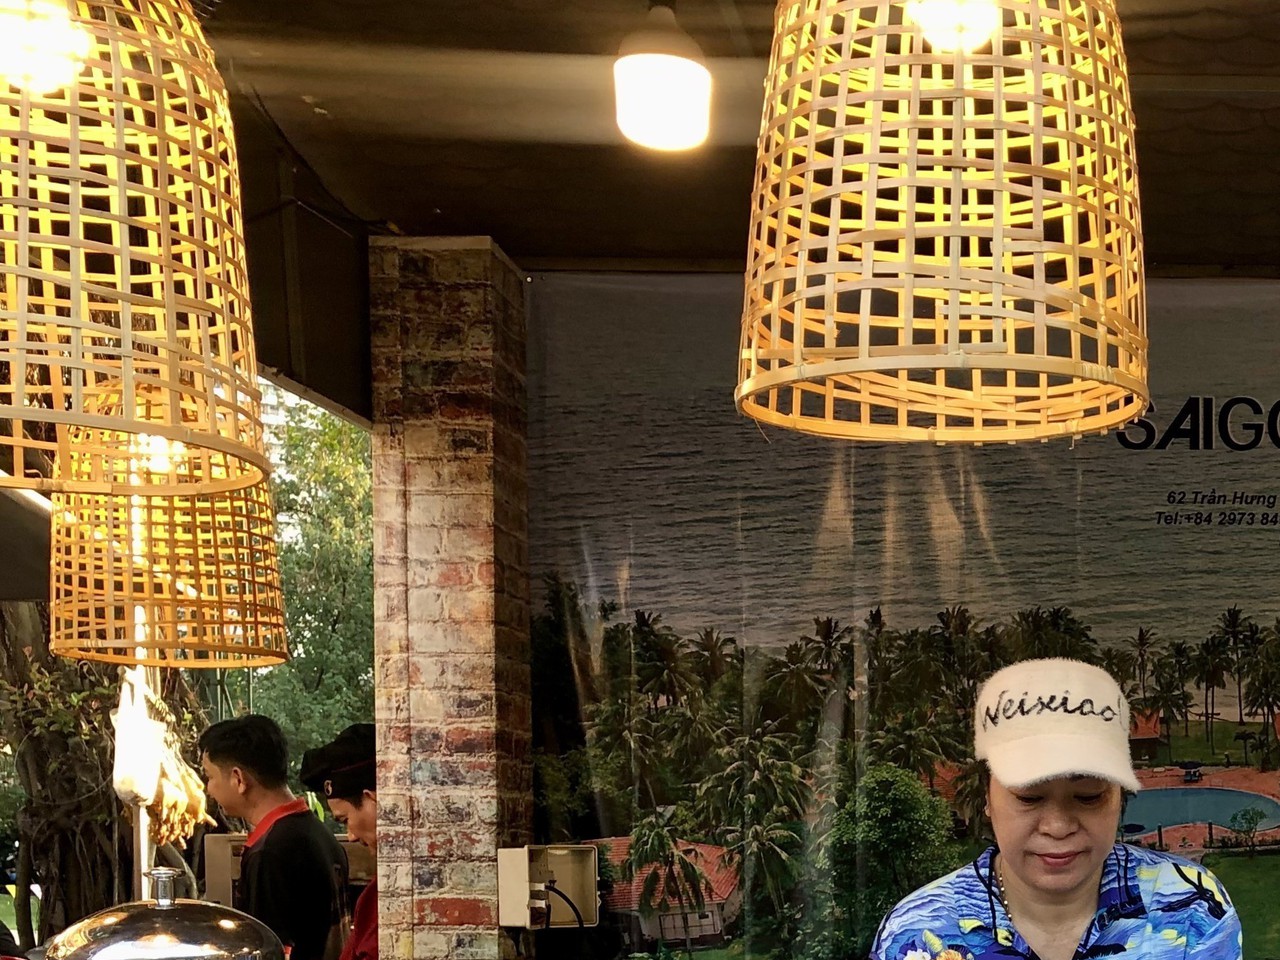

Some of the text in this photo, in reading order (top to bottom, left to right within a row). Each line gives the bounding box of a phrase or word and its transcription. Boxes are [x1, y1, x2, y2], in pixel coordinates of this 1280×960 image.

[1166, 492, 1186, 505] 62
[1192, 489, 1227, 505] Trần
[1232, 492, 1277, 508] Hưng
[1155, 512, 1212, 526] Tel:+84
[1218, 512, 1254, 526] 2973
